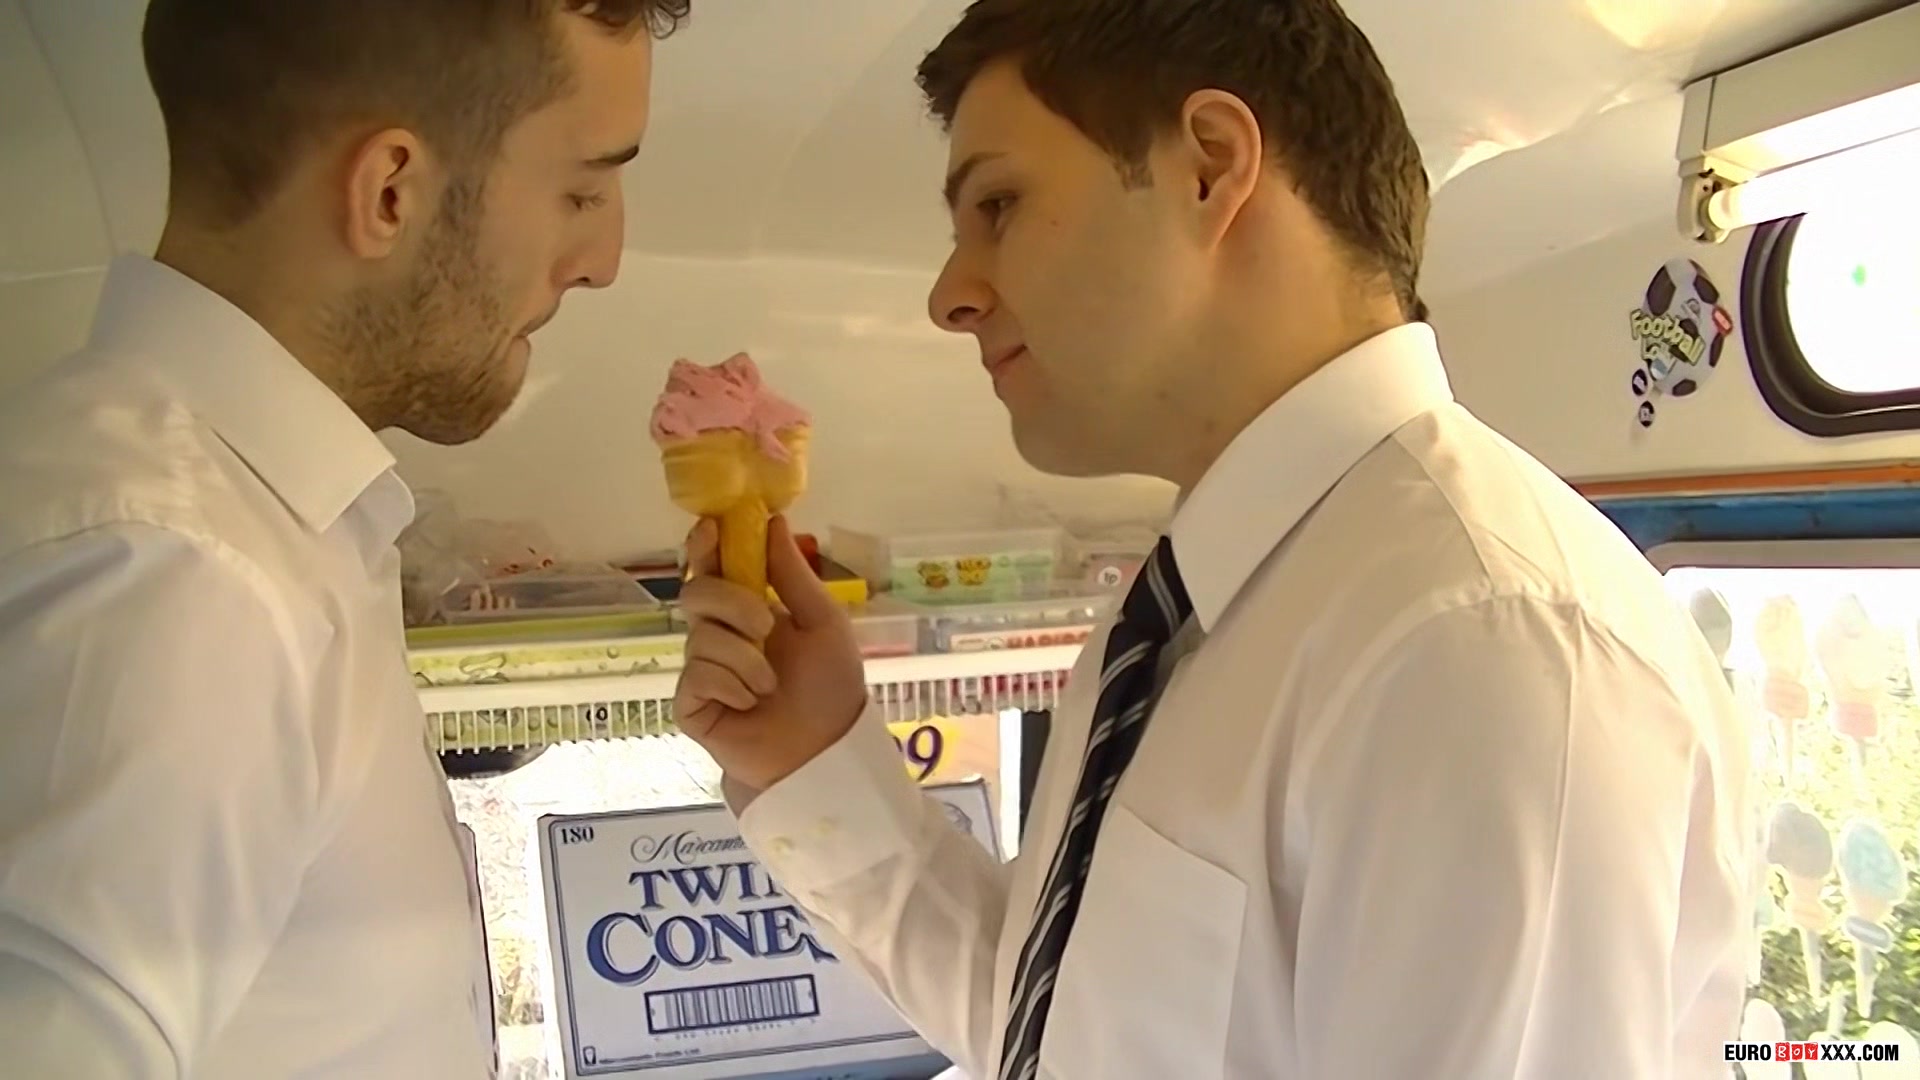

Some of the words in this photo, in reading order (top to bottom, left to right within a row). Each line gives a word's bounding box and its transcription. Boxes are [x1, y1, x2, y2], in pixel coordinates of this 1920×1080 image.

[1629, 308, 1706, 366] Football
[892, 725, 944, 783] 9
[557, 827, 595, 845] 180
